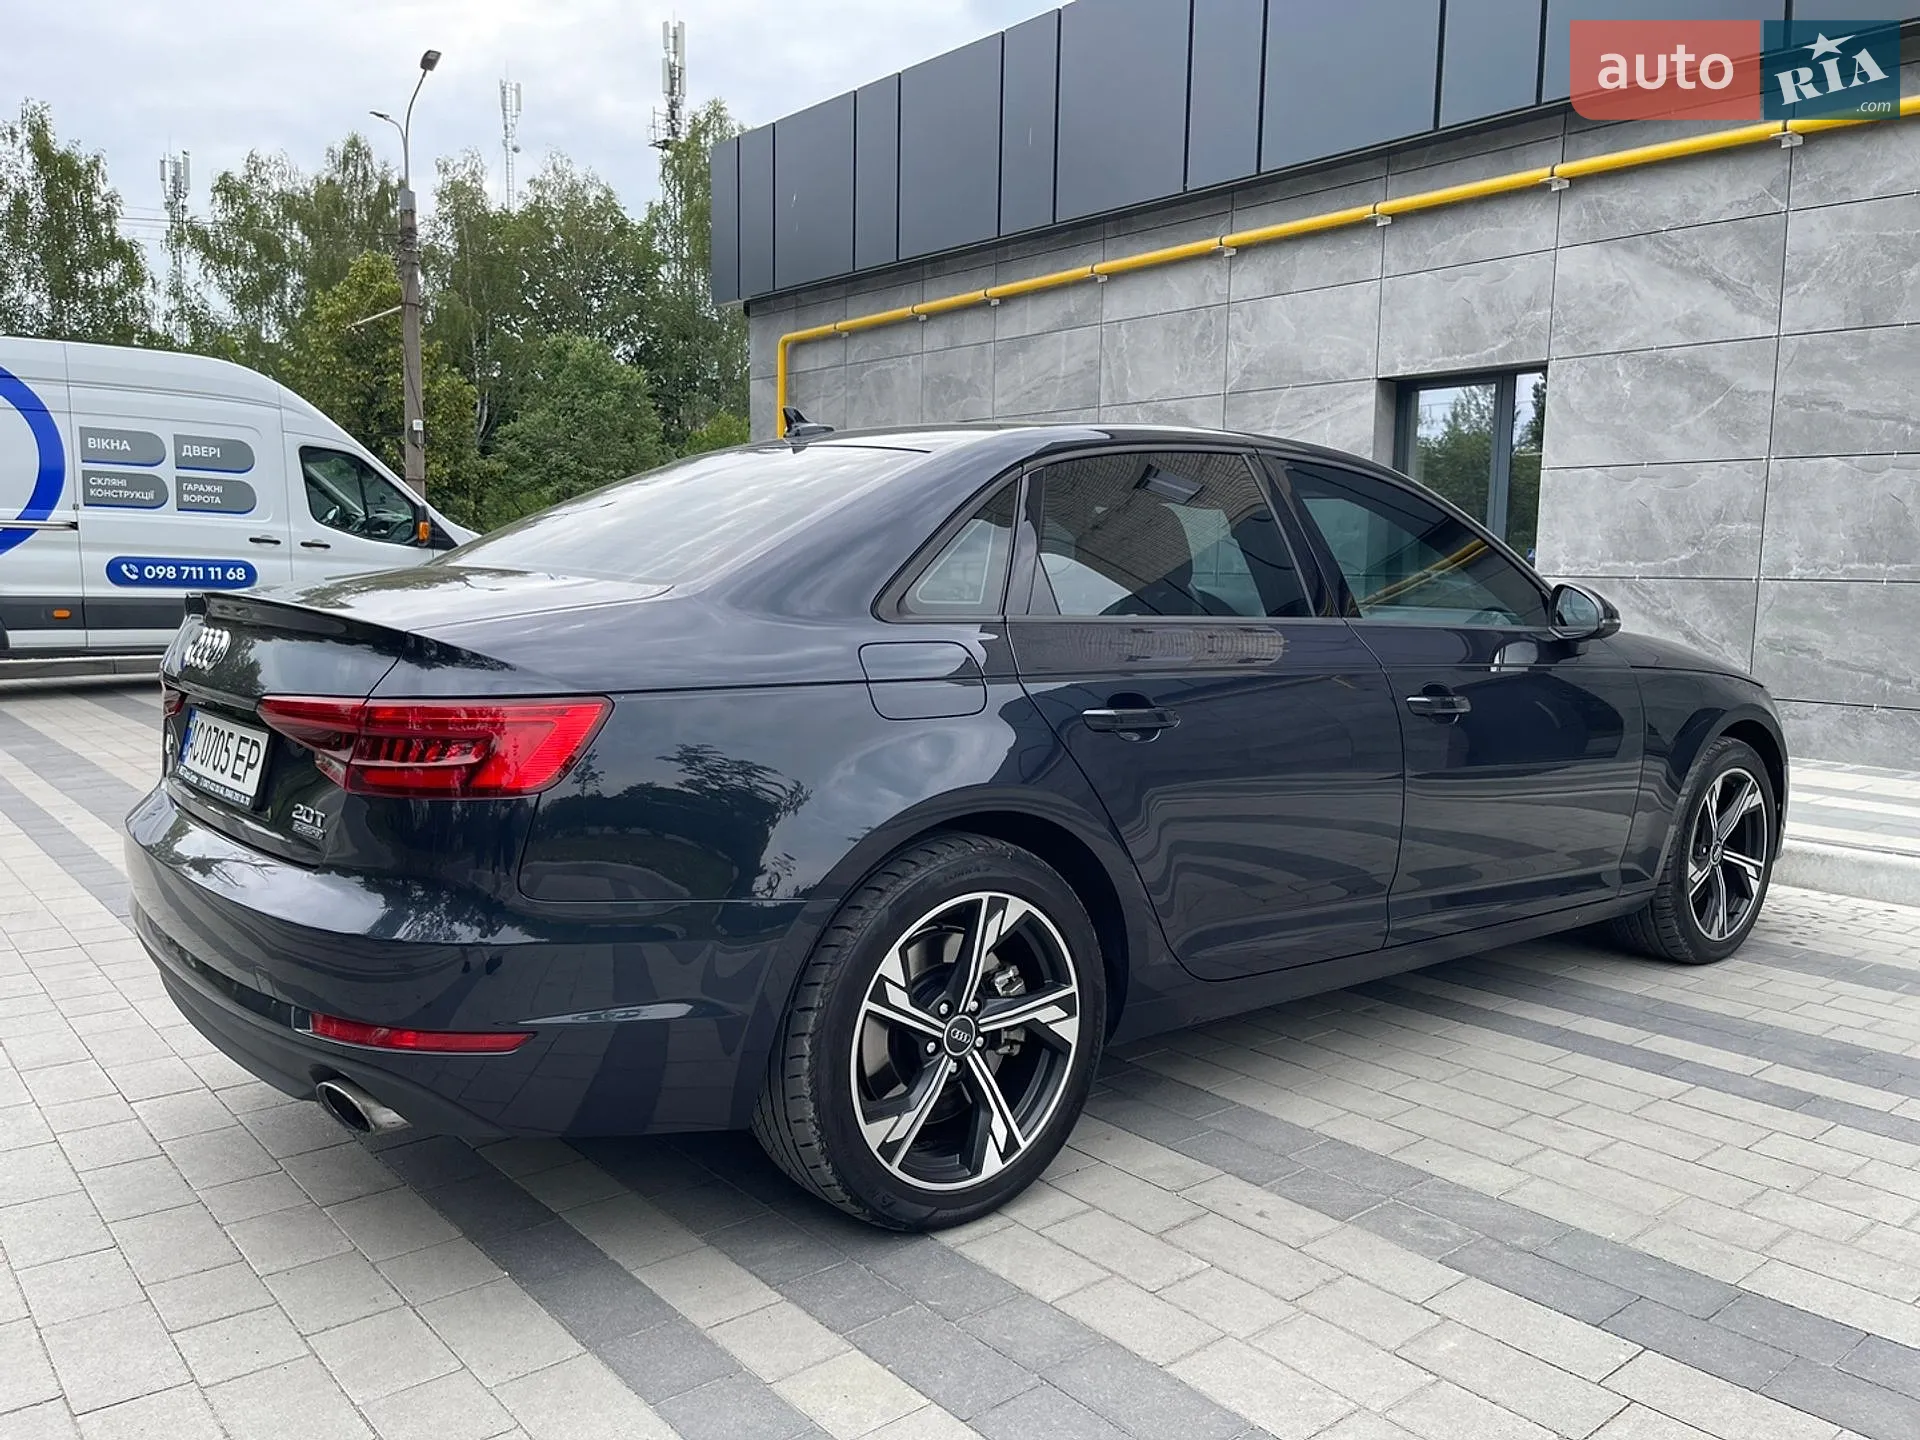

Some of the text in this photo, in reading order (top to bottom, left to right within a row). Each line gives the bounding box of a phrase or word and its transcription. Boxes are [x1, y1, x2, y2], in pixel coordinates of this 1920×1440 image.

[87, 437, 132, 452] ВІКНА
[181, 444, 221, 458] ДВЕРІ
[89, 477, 127, 487] СКЛЯНІ
[182, 483, 223, 493] ГАРАЖНІ
[89, 488, 155, 500] КОНСТРУКЦІЇ
[182, 494, 221, 504] ВОРОТА
[144, 565, 246, 581] 098 711 11 68
